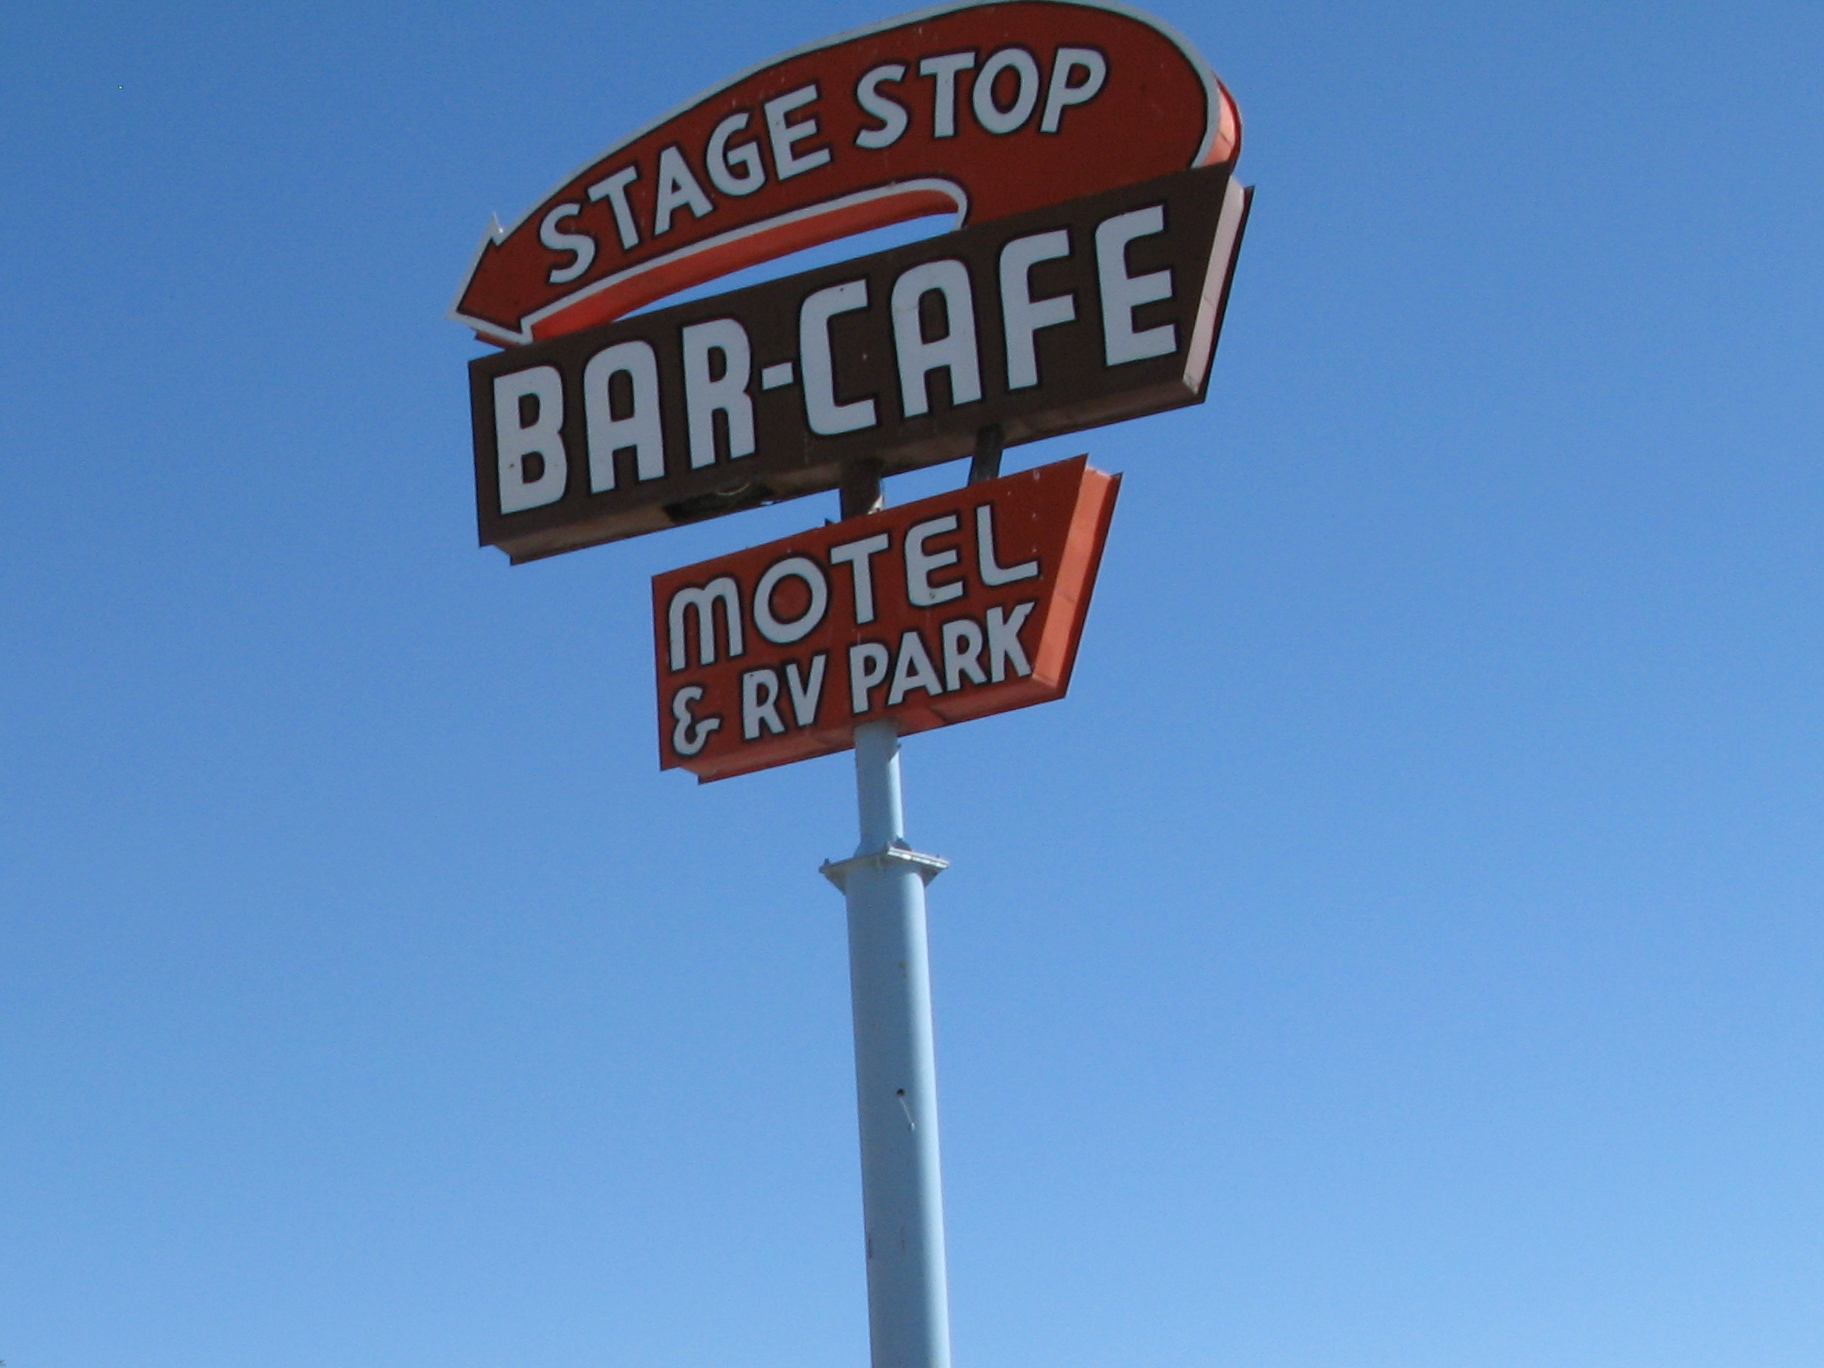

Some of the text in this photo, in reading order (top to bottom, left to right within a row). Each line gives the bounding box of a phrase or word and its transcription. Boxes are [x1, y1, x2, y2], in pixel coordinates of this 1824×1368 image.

[539, 46, 1108, 284] STAGE STOP
[493, 205, 1177, 515] BAR-CAFE
[668, 505, 1038, 672] MOTEL
[672, 601, 1034, 757] & RV PARK
